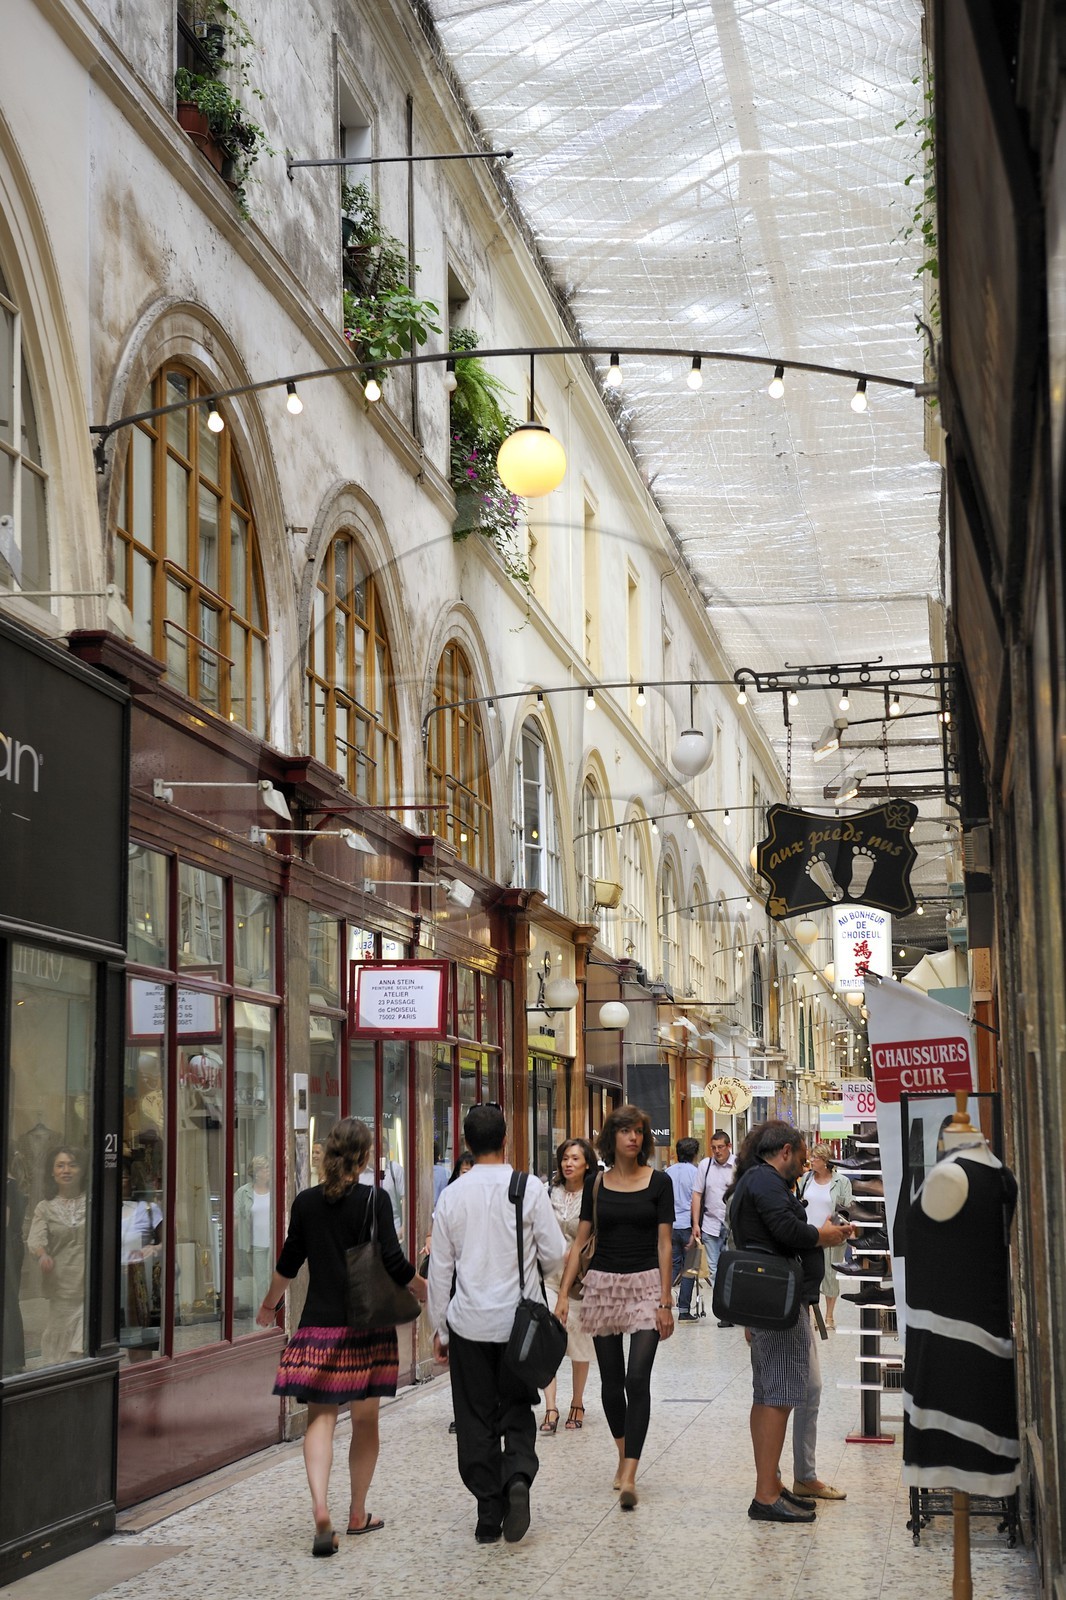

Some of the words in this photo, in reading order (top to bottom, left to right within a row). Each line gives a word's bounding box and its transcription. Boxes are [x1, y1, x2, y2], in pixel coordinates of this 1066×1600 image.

[769, 840, 806, 870] aux
[808, 822, 864, 853] pieds
[867, 835, 903, 856] nus
[837, 915, 849, 926] AU
[849, 910, 885, 925] BONHEUR
[856, 921, 867, 929] DE
[842, 930, 881, 939] CHOISEUL
[875, 1043, 967, 1069] CHAUSSURES
[900, 1067, 947, 1088] CUIR
[707, 1082, 717, 1094] La
[848, 1084, 874, 1093] REDS
[104, 1133, 118, 1153] 21
